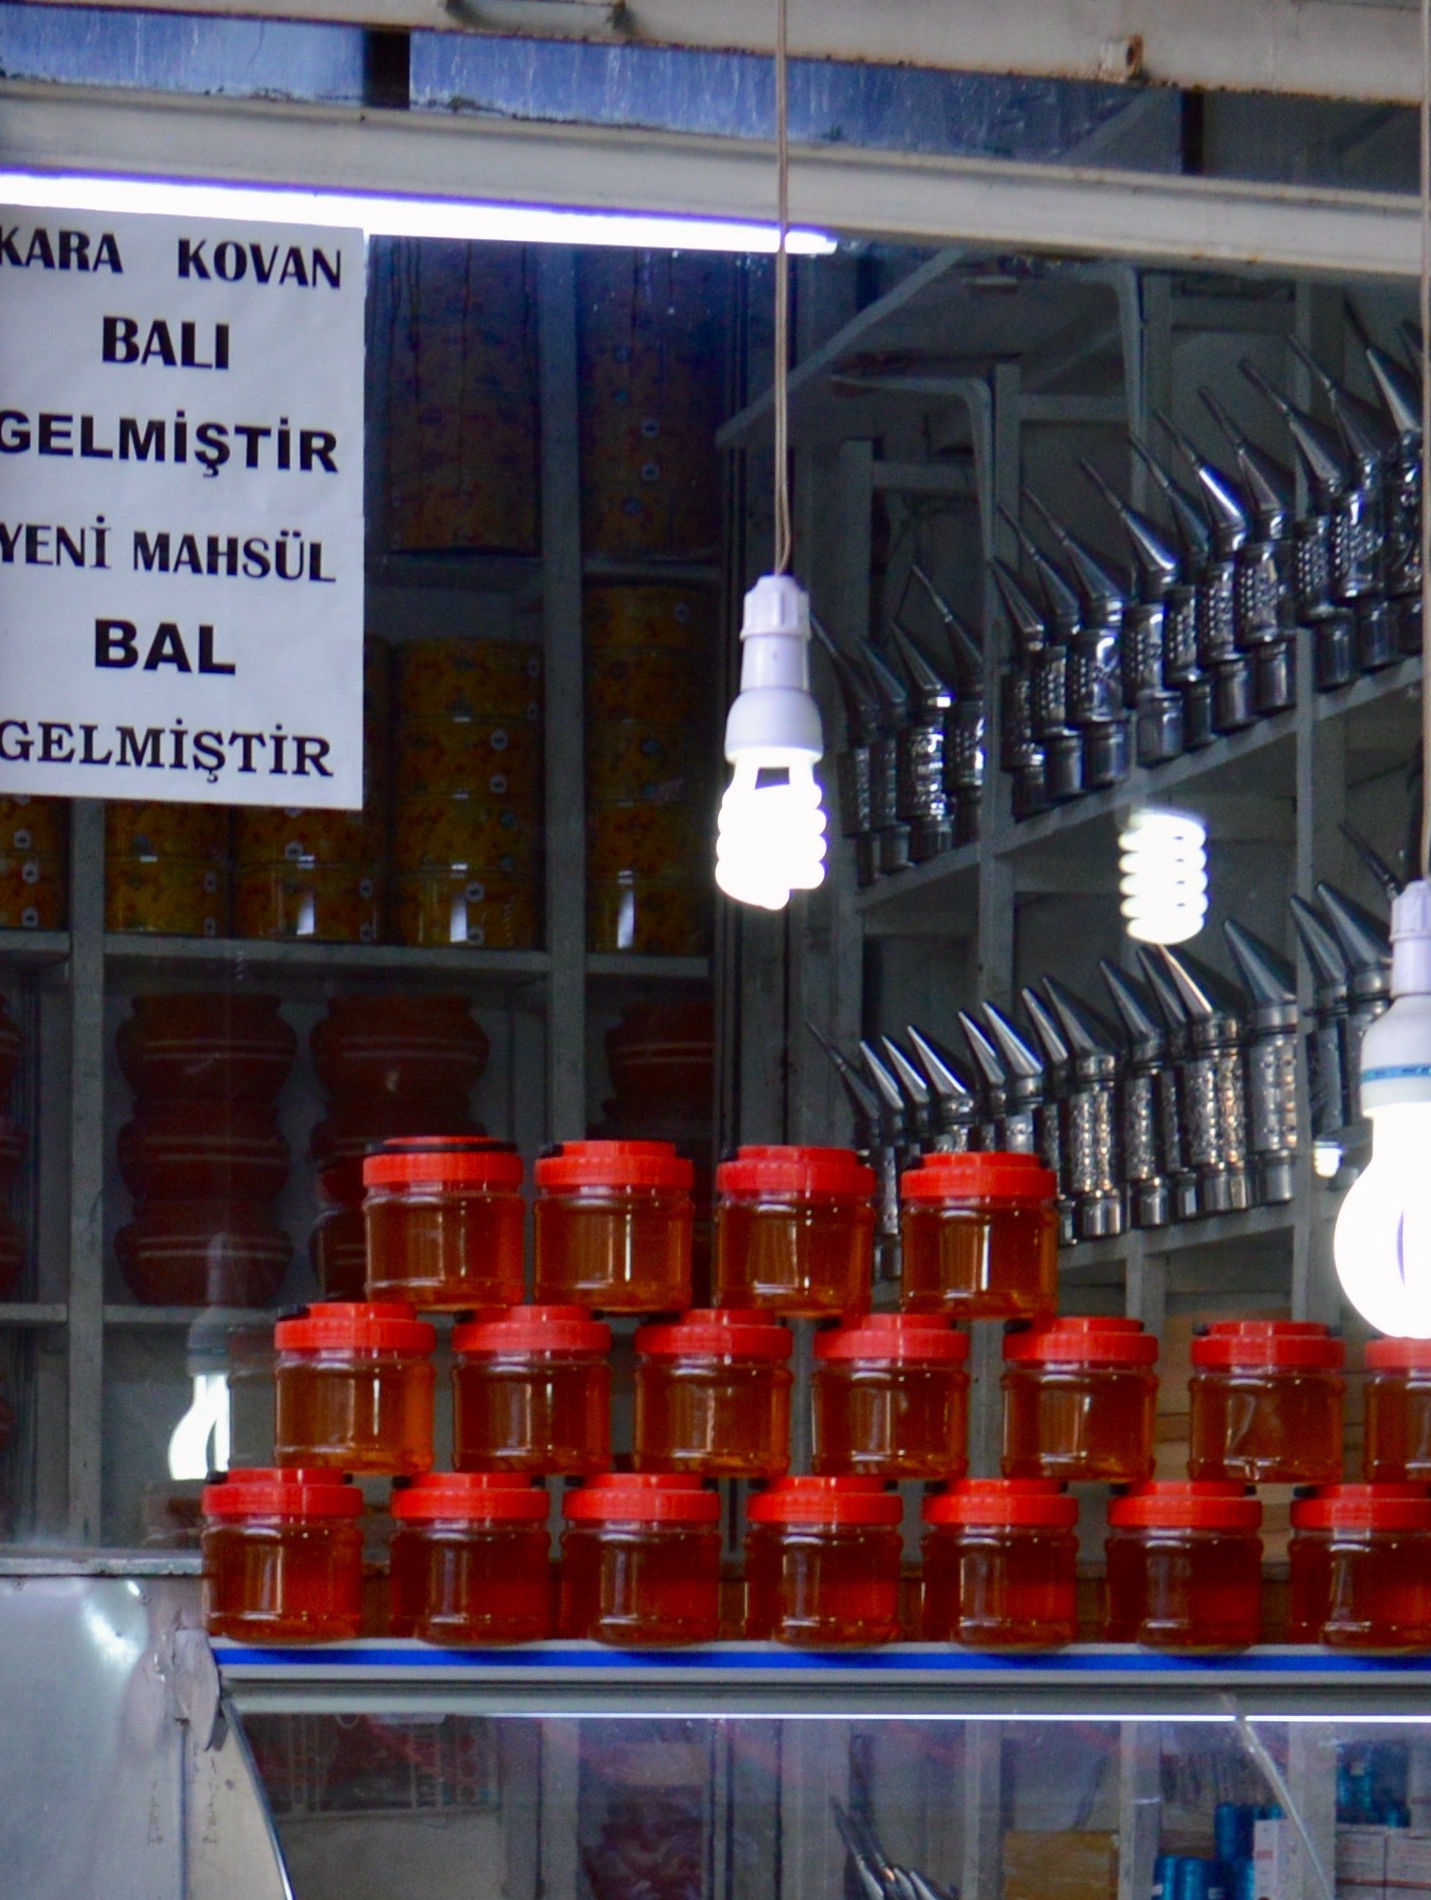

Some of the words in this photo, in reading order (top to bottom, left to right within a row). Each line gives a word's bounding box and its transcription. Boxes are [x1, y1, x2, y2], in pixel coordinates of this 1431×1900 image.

[177, 238, 341, 289] KOVAN
[102, 316, 229, 370] BALI
[133, 530, 337, 583] MAHSÜL
[94, 618, 236, 675] BAL
